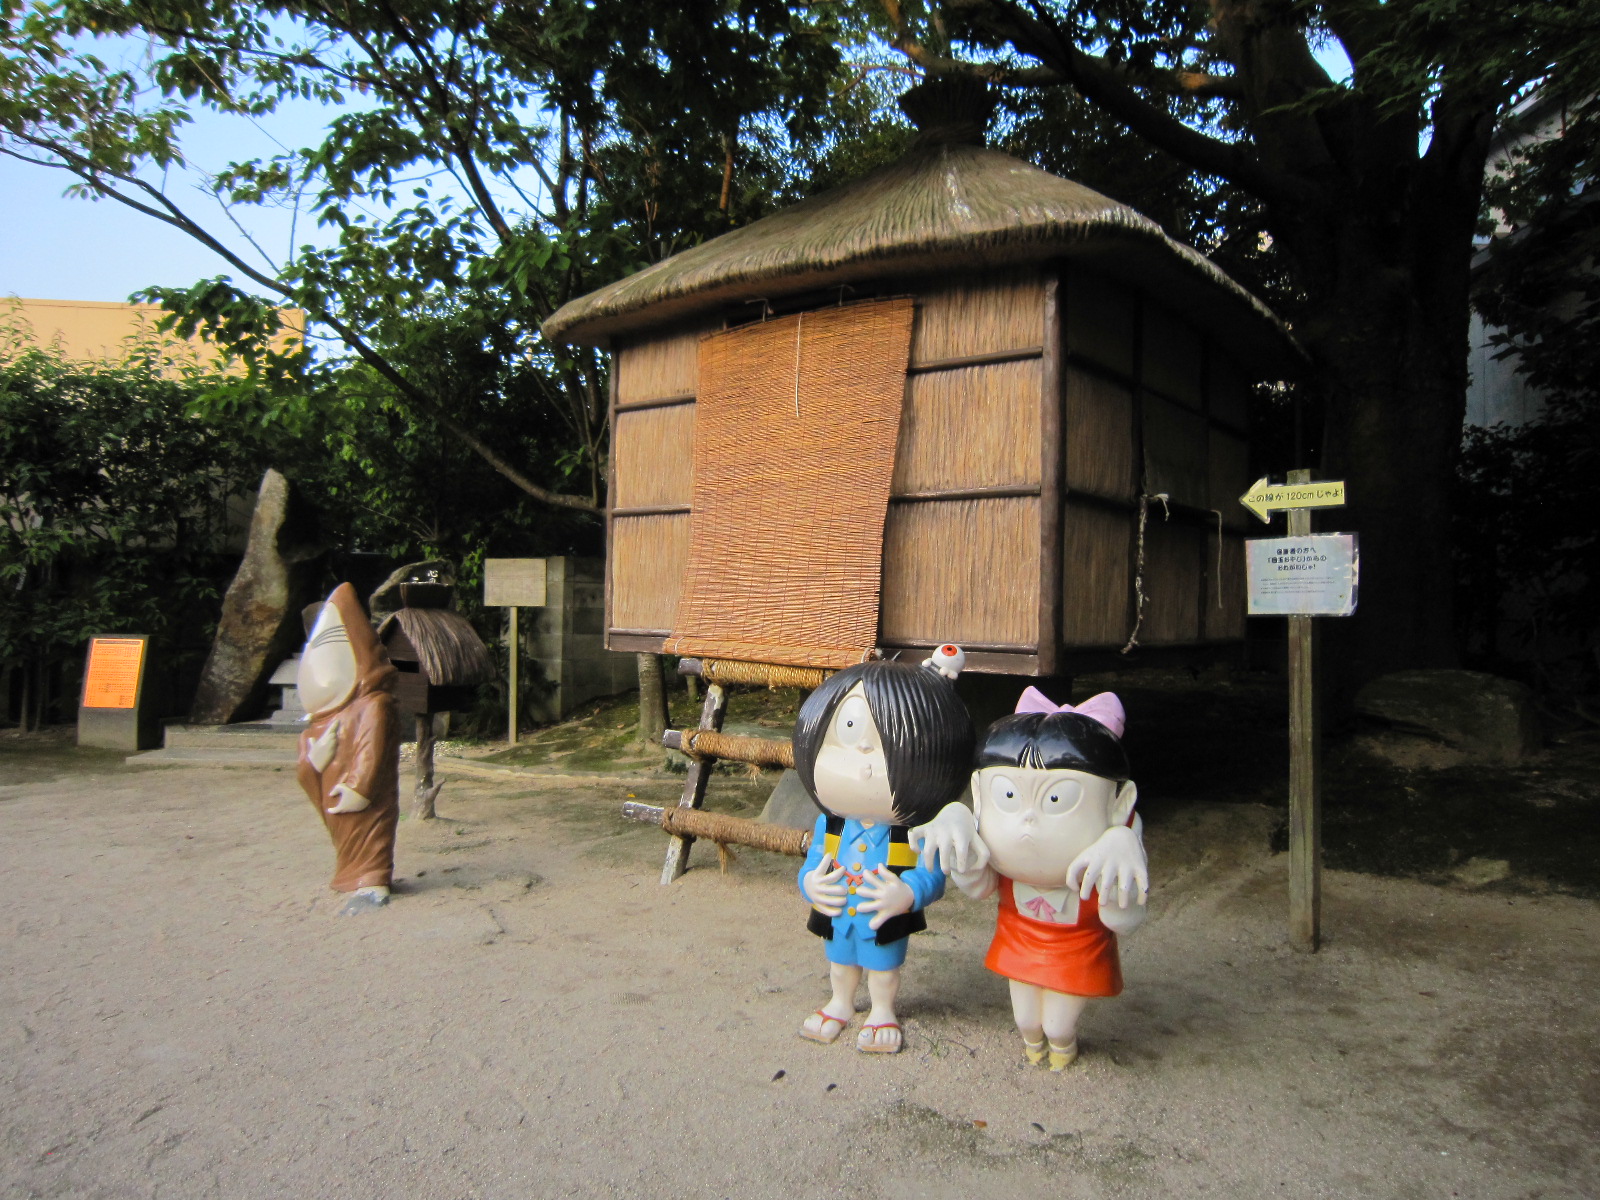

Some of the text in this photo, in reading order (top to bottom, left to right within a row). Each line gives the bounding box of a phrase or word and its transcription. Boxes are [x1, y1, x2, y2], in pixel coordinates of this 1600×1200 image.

[1249, 493, 1284, 503] この線が
[1287, 491, 1314, 501] 120cm
